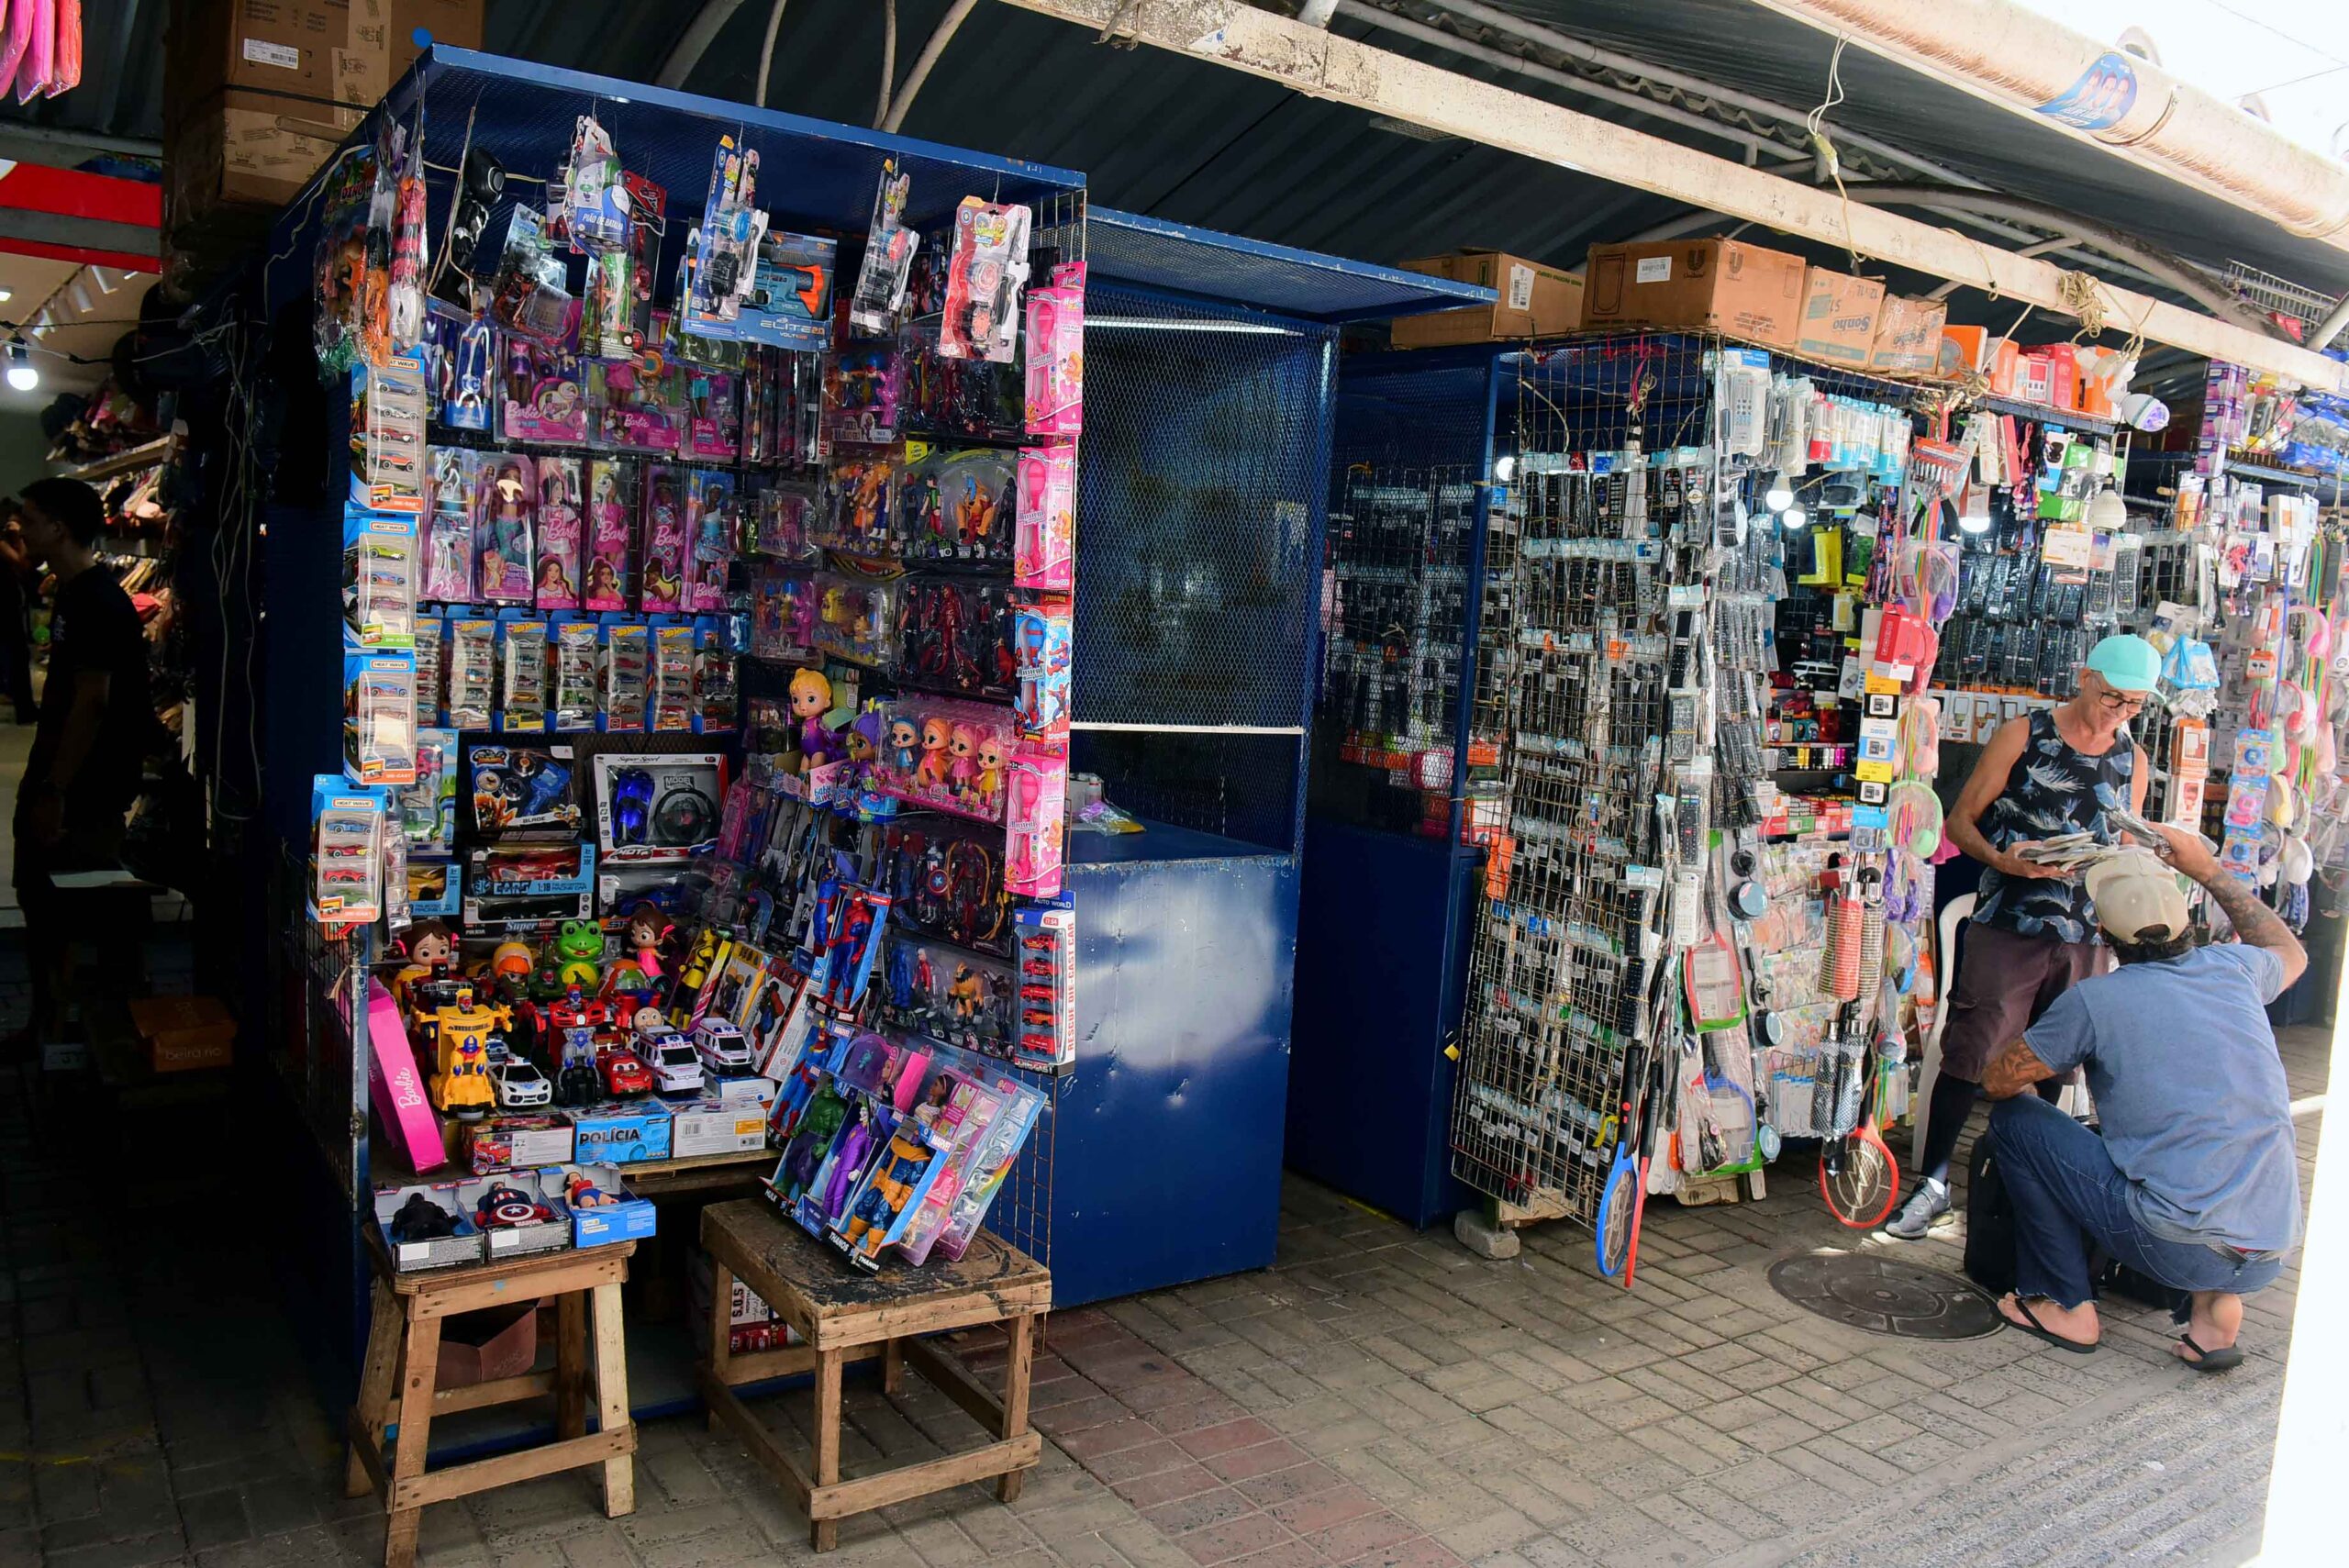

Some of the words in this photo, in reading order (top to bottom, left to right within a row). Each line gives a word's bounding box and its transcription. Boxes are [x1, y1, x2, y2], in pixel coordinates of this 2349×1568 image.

[761, 319, 811, 333] ELITE
[1833, 316, 1871, 332] Sonho
[507, 403, 540, 418] Barbie
[624, 414, 650, 428] Barbie
[1034, 897, 1050, 906] AUTO
[1052, 900, 1071, 909] WORLD
[505, 920, 538, 932] Super
[398, 1067, 422, 1109] Barbie
[579, 1127, 641, 1145] POLÍCIA
[931, 1134, 952, 1151] MARVEL
[764, 1189, 777, 1203] HULK
[829, 1231, 850, 1252] THANOS
[858, 1255, 880, 1271] THANOS
